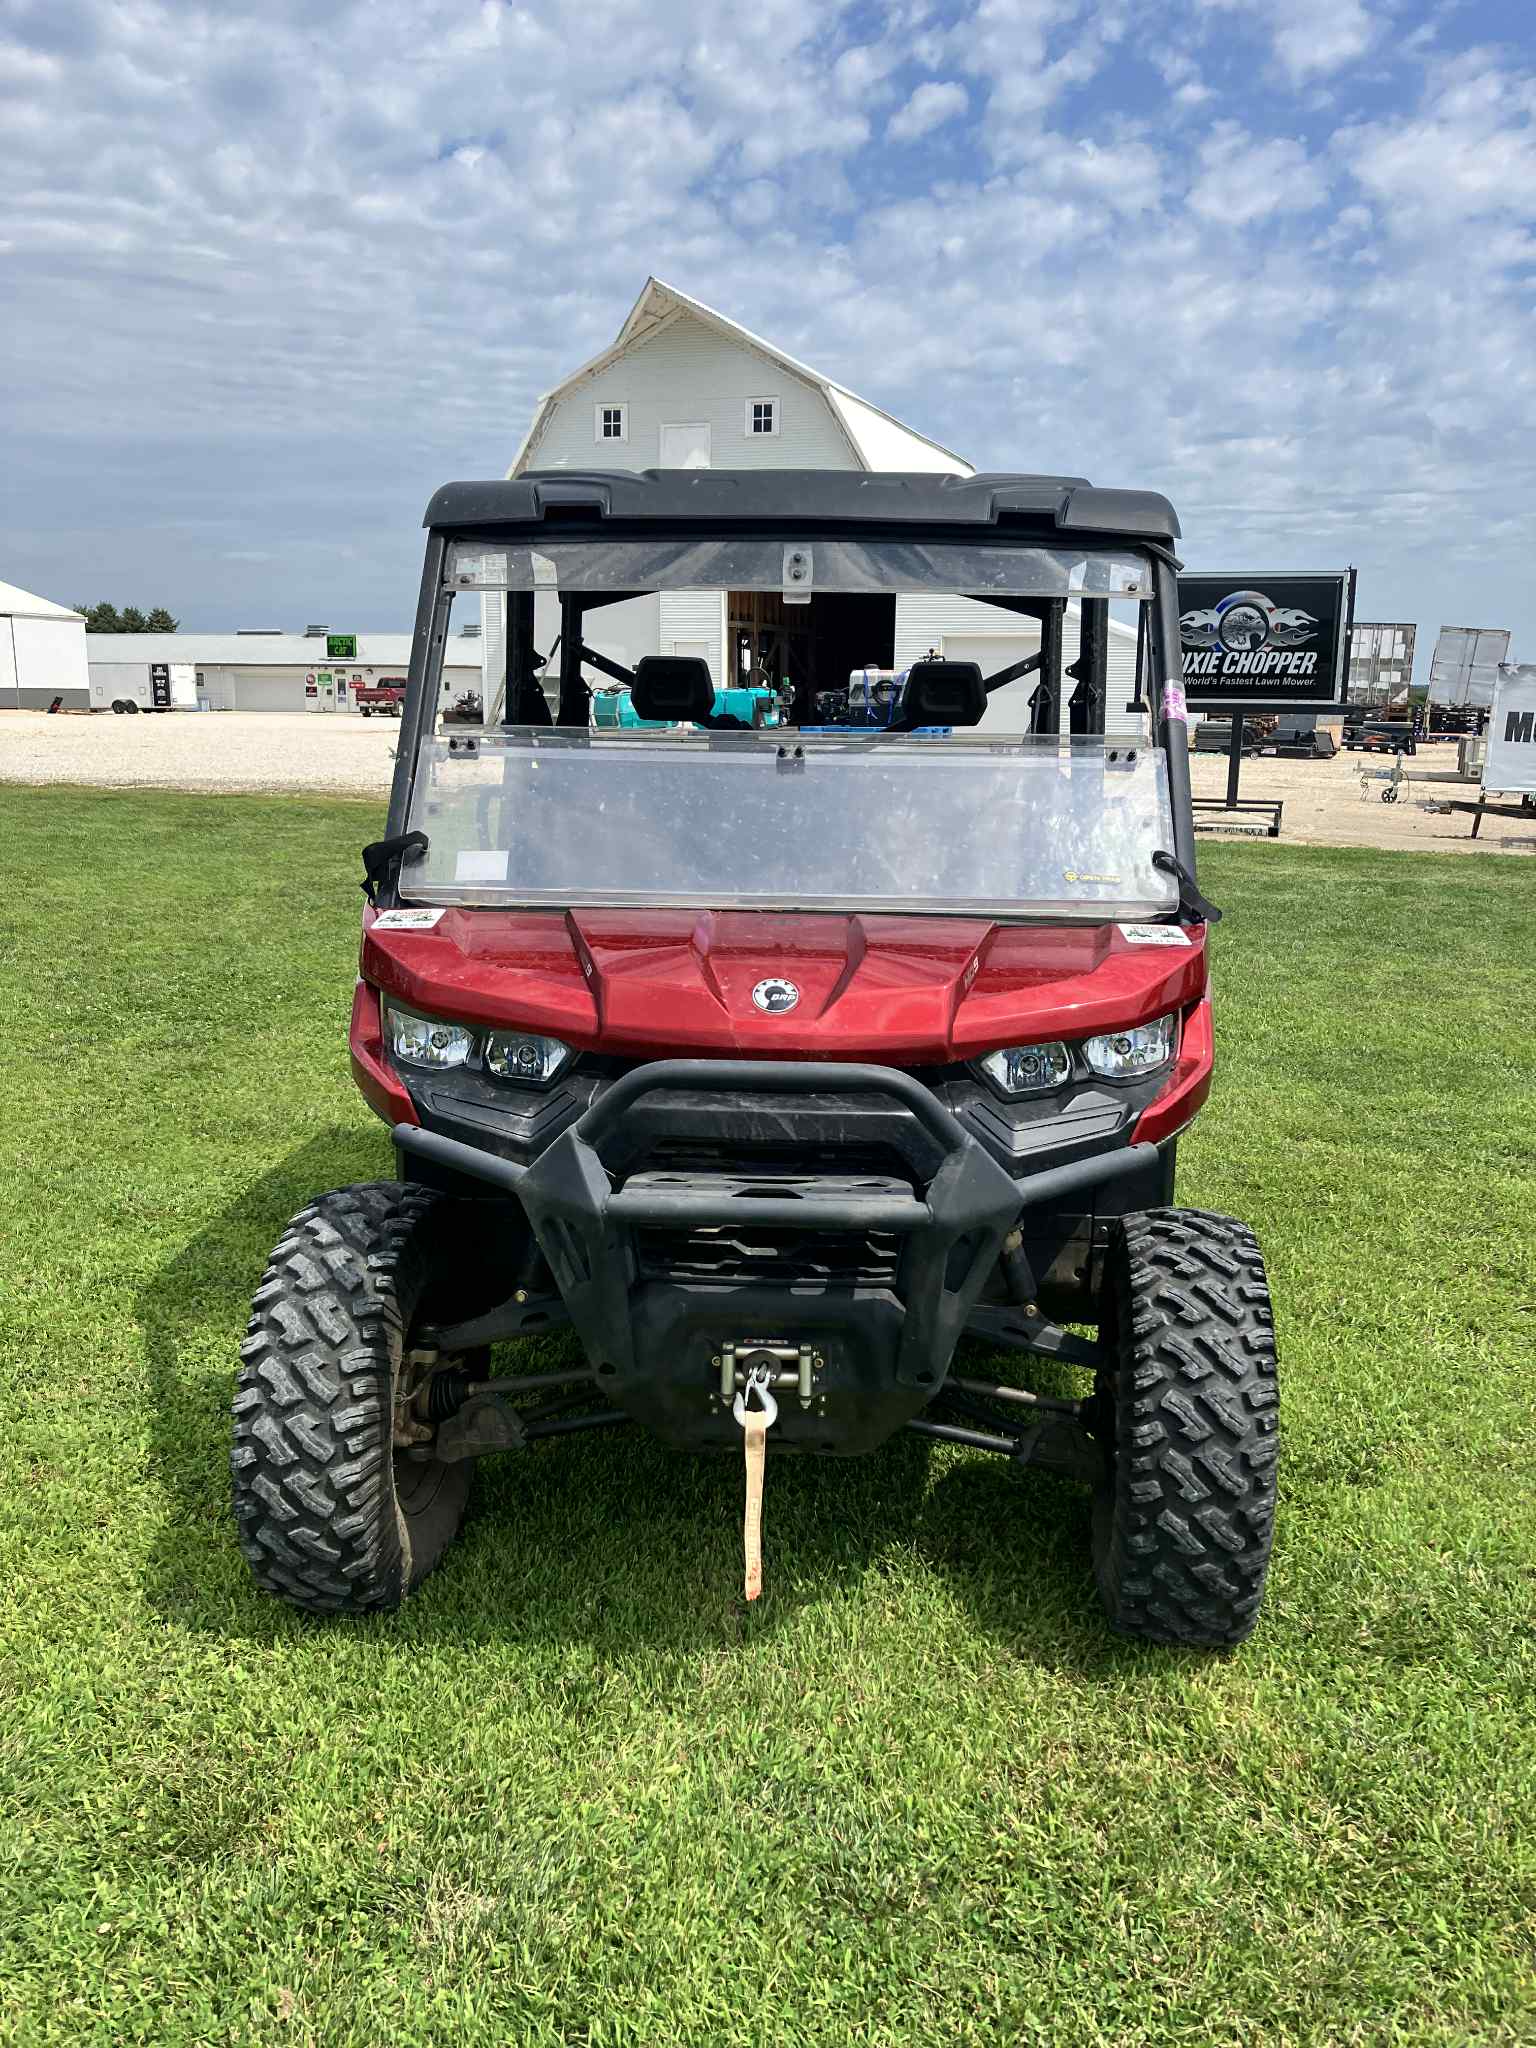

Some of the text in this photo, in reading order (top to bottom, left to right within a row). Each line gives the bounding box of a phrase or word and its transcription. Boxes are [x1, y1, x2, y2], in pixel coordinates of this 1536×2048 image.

[1181, 651, 1318, 674] IXIE CHOPPER
[1184, 677, 1217, 686] World's
[1219, 677, 1254, 686] Fastest
[1255, 677, 1280, 686] Lawn
[1504, 711, 1536, 743] M
[770, 993, 796, 1001] BRP
